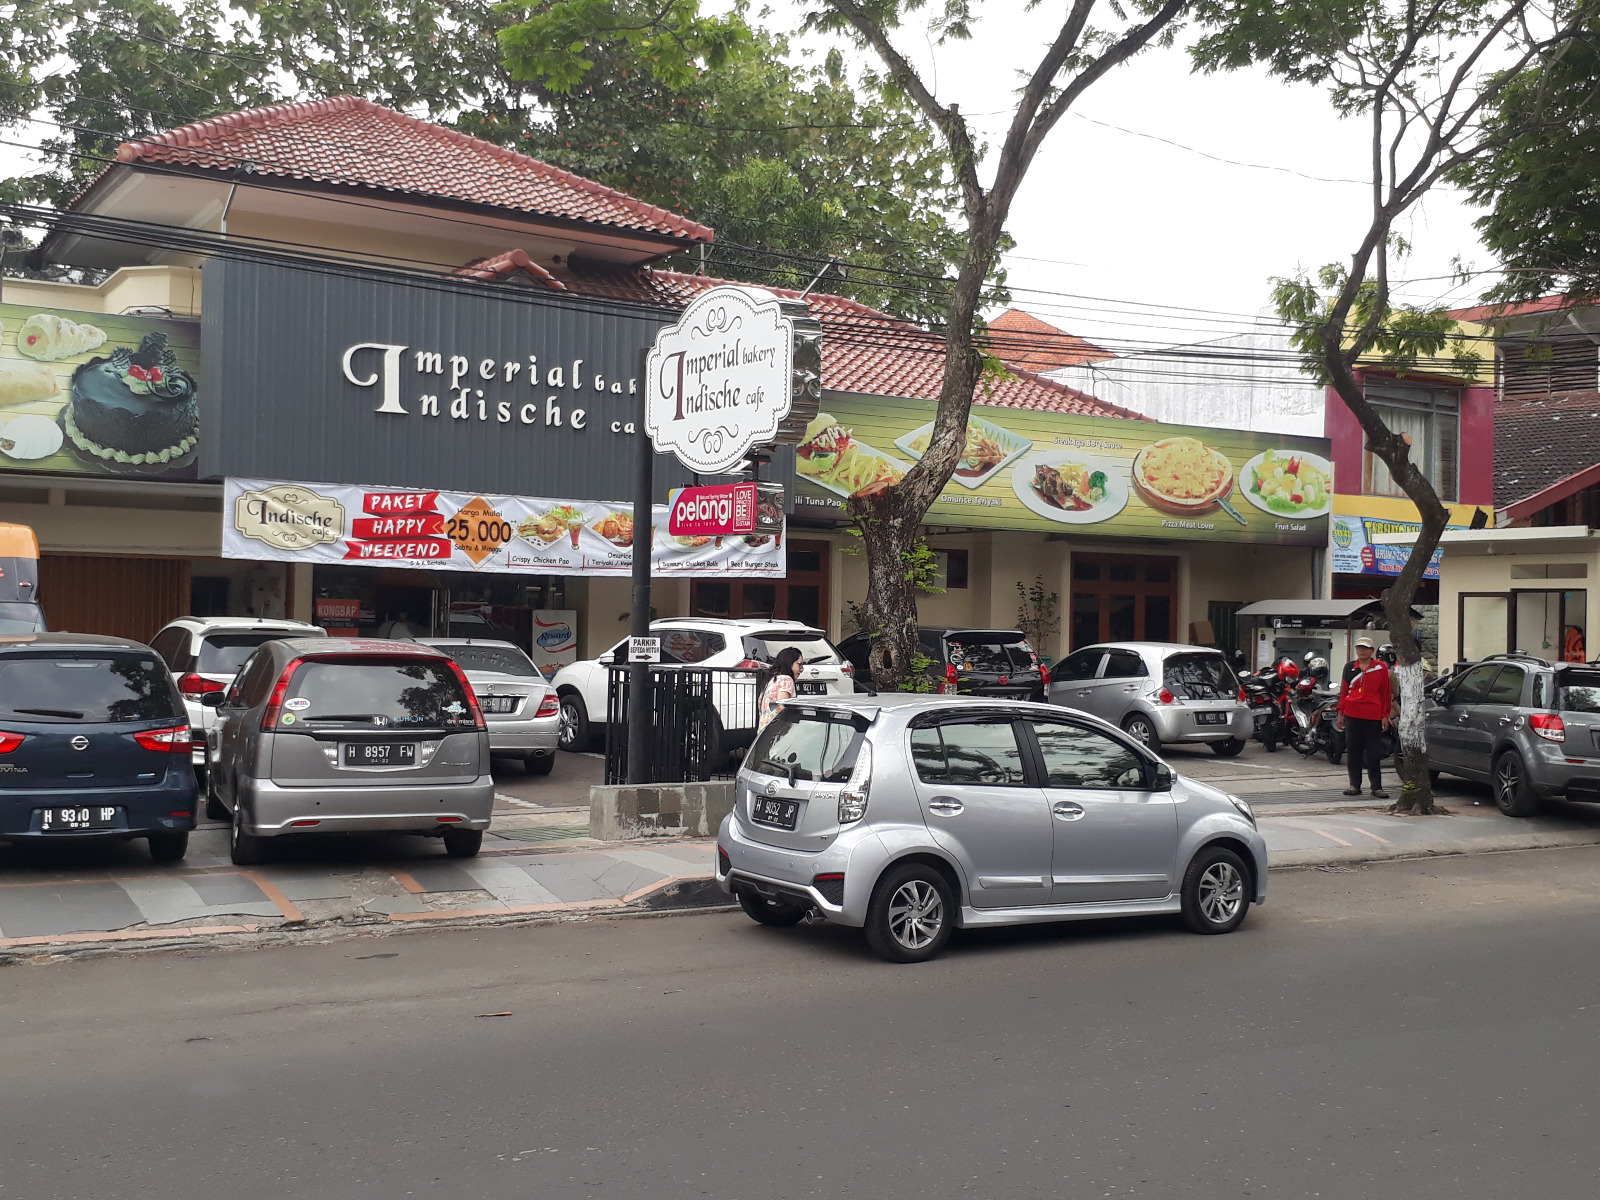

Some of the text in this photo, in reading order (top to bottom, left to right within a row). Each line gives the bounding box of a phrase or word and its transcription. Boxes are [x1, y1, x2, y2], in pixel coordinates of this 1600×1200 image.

[343, 343, 584, 391] Imperial
[660, 338, 775, 390] Imperial bakery
[746, 386, 764, 412] cafe
[1053, 436, 1074, 446] Steak
[1086, 441, 1101, 449] BBQ
[1102, 442, 1122, 451] Sauce
[736, 490, 752, 500] LOVE
[941, 494, 1002, 507] Omurice Teriyaki
[371, 494, 427, 511] PAKET
[806, 497, 825, 506] Tuna
[826, 498, 842, 507] Pao
[457, 507, 480, 517] Harga
[676, 492, 733, 528] pelangi
[736, 505, 747, 517] BE
[247, 500, 333, 540] Indische cafe
[1161, 520, 1215, 530] Pizza Meat Lover
[372, 518, 427, 535] HAPPY
[447, 519, 512, 543] 25.000
[1275, 523, 1306, 532] Fruit Salad
[360, 542, 441, 558] WEEKEND
[474, 543, 479, 551] &
[481, 545, 502, 553] Minggu
[512, 555, 531, 564] Crispy
[533, 556, 557, 565] Chicken
[662, 560, 684, 568] Savoury
[685, 560, 706, 568] Chicken
[745, 560, 762, 569] Burger
[318, 605, 357, 617] KONGBAP
[541, 631, 570, 641] Reward
[633, 638, 657, 646] PARKIR
[348, 745, 414, 757] H 8957 FW
[755, 799, 795, 818] H 9052 JP
[44, 810, 53, 823] H
[101, 807, 115, 821] HP
